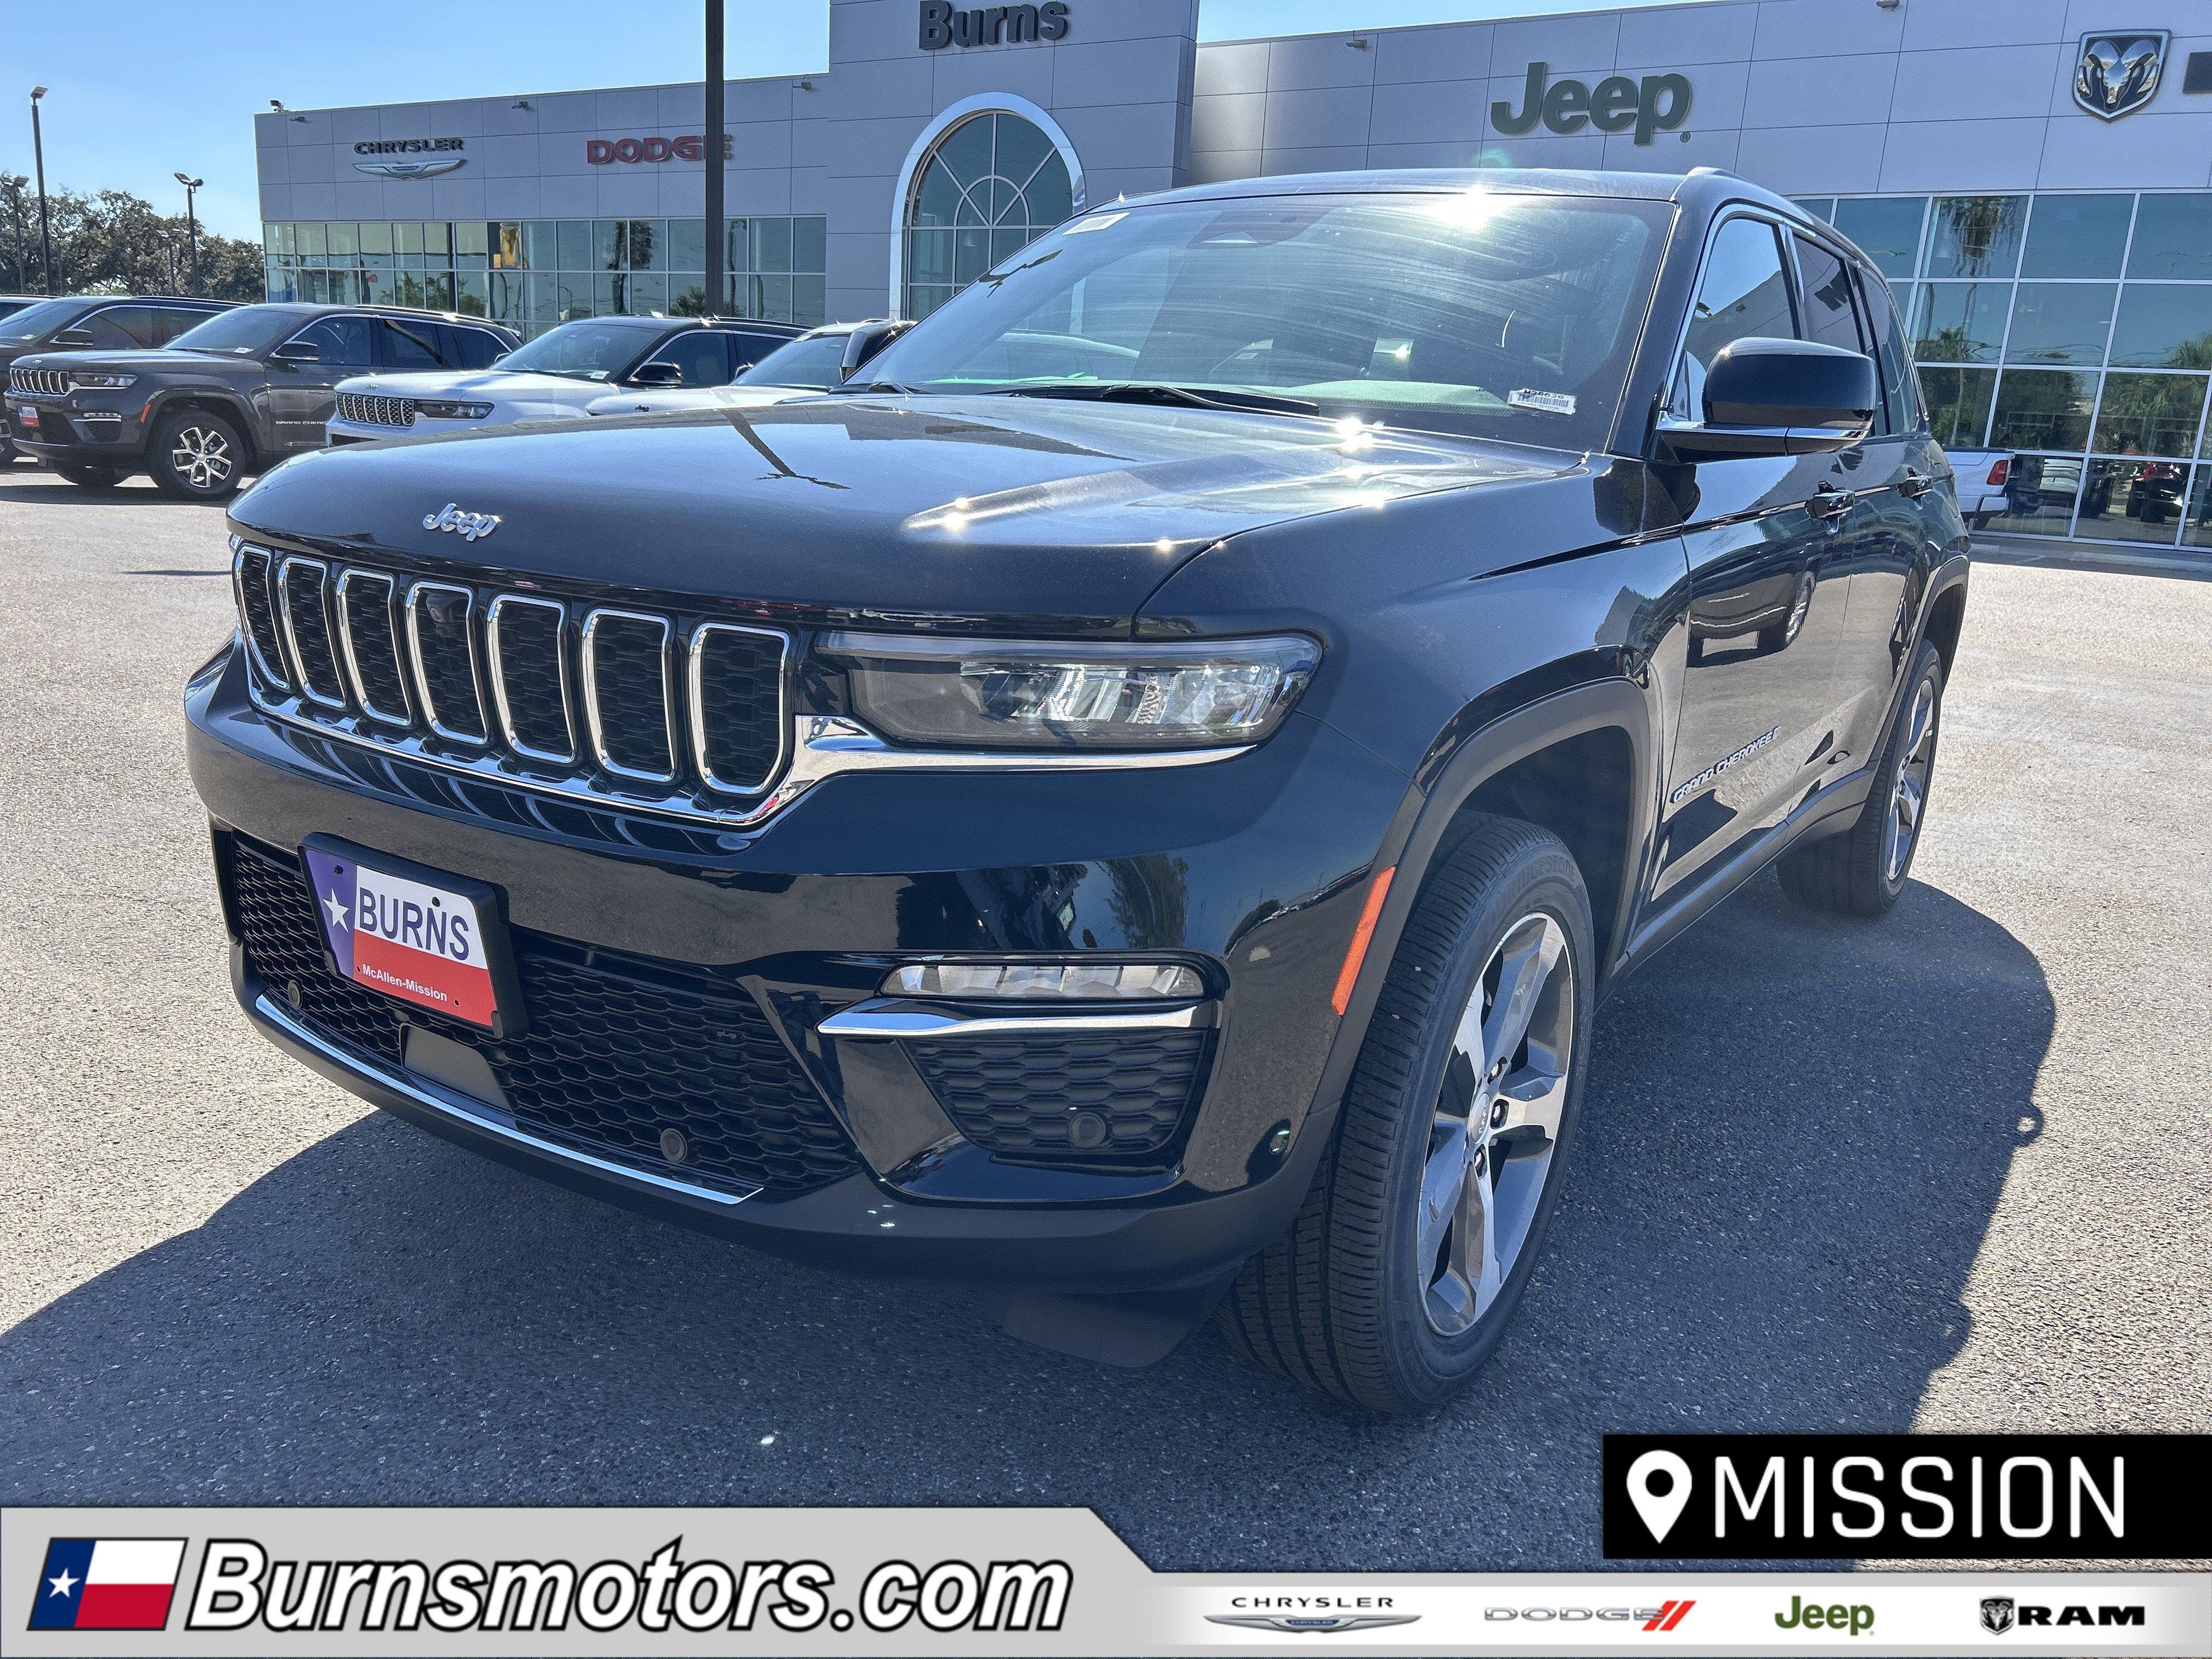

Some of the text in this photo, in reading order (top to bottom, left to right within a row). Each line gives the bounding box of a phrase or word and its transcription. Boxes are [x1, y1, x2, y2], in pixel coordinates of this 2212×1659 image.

[919, 1, 1068, 50] Burns
[1491, 61, 1692, 145] Jeep
[354, 138, 464, 154] CHRYSLER
[422, 503, 501, 541] Jeep
[1671, 732, 1773, 803] GRAND CHEROKEE
[359, 887, 470, 961] BURNS
[362, 963, 448, 1002] McAllen-Mission
